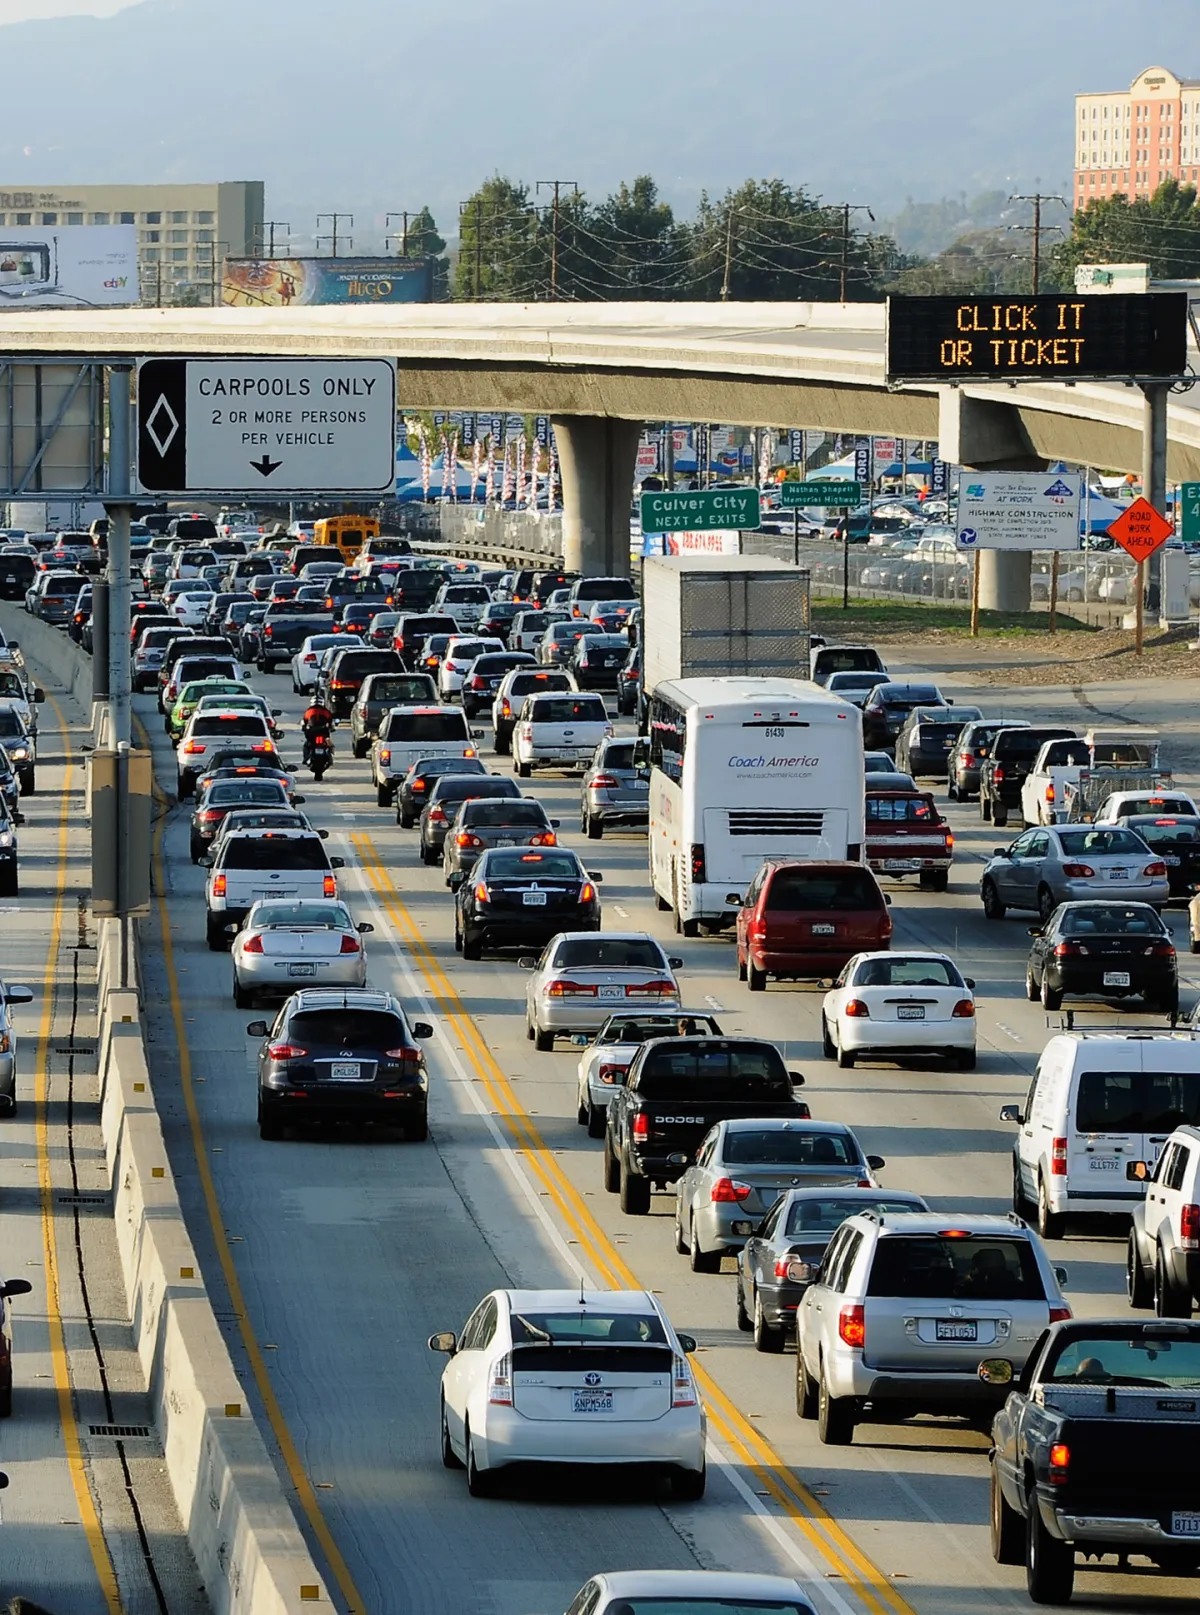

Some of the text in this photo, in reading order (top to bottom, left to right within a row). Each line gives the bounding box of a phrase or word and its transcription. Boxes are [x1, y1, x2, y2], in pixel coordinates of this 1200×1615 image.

[348, 281, 393, 297] HUGO
[957, 304, 1086, 331] CLICK IT
[940, 338, 1086, 366] OR TICKET
[199, 378, 377, 396] CARPOOLS ONLY
[211, 409, 367, 424] 2 OR MORE PERSONS
[241, 433, 335, 445] PER VEHICLE
[792, 430, 802, 460] FORD
[857, 450, 867, 482] FORD
[652, 496, 747, 511] Culver City
[824, 496, 859, 504] Highway
[968, 509, 1074, 518] HIGHWAY CONSTRUCTION
[1129, 512, 1151, 521] ROAD
[655, 514, 746, 527] NEXT 4 EXITS
[1128, 524, 1151, 532] WORK
[1126, 537, 1155, 547] AHEAD
[728, 755, 820, 768] Coach America
[655, 1116, 705, 1124] DODGE
